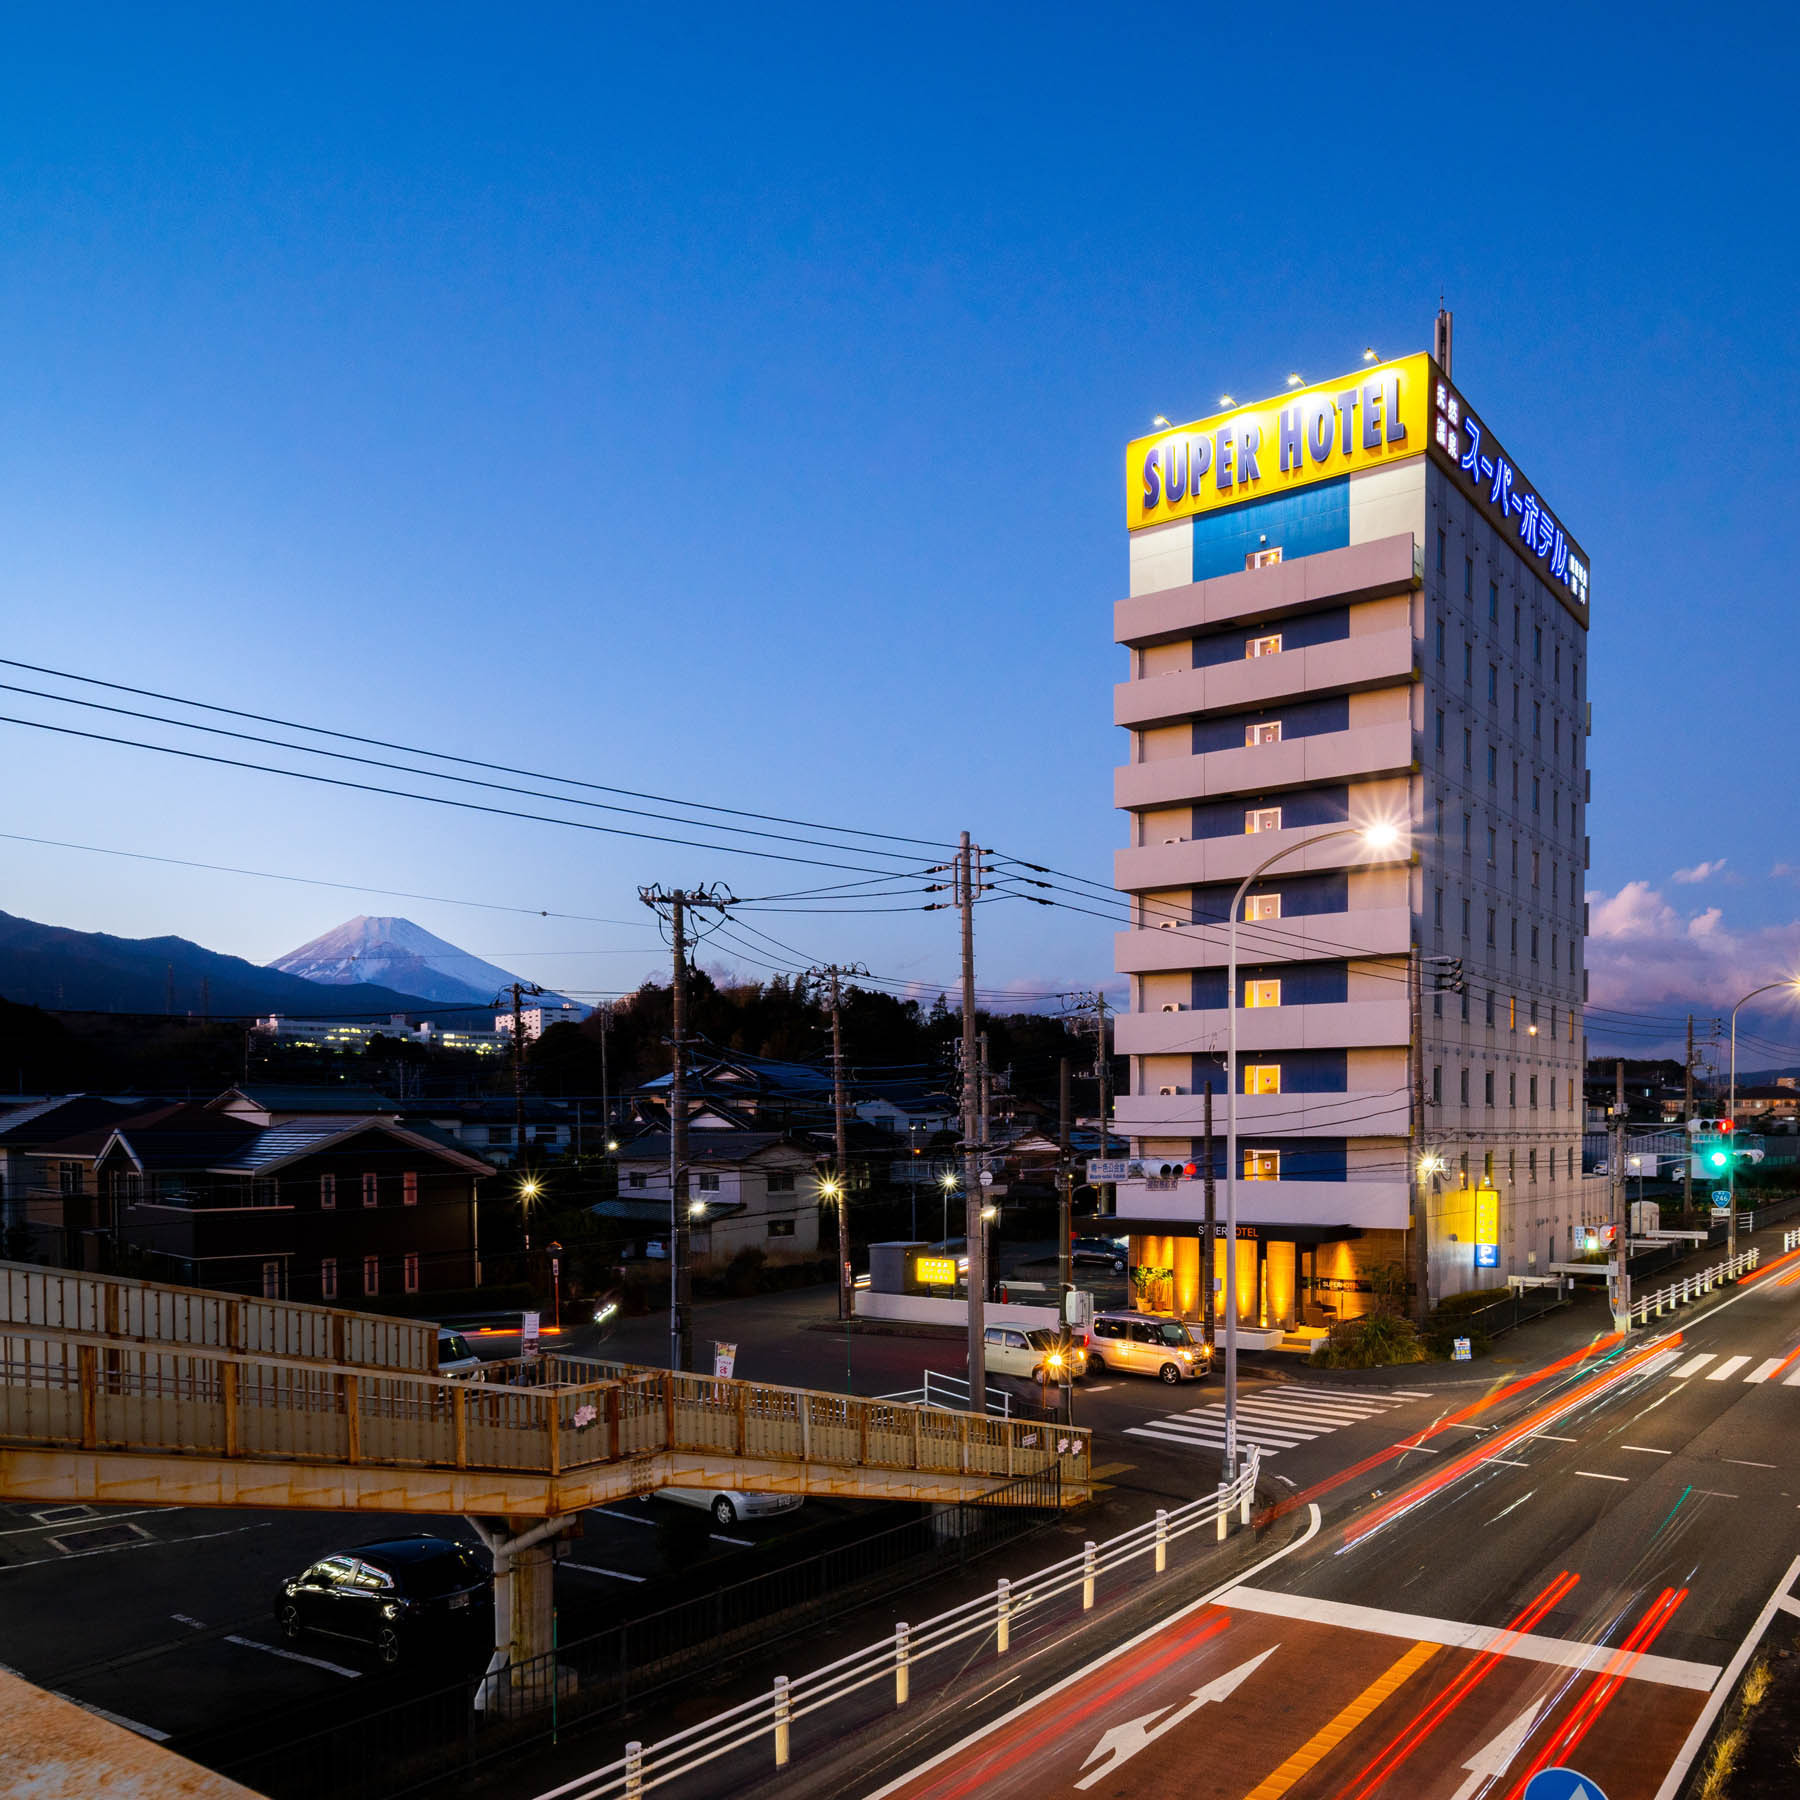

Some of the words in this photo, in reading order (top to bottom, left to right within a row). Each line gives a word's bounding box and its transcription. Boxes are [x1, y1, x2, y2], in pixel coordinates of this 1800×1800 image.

[1143, 416, 1261, 508] SUPER
[1280, 375, 1406, 472] HOTEL
[1481, 1246, 1493, 1257] P
